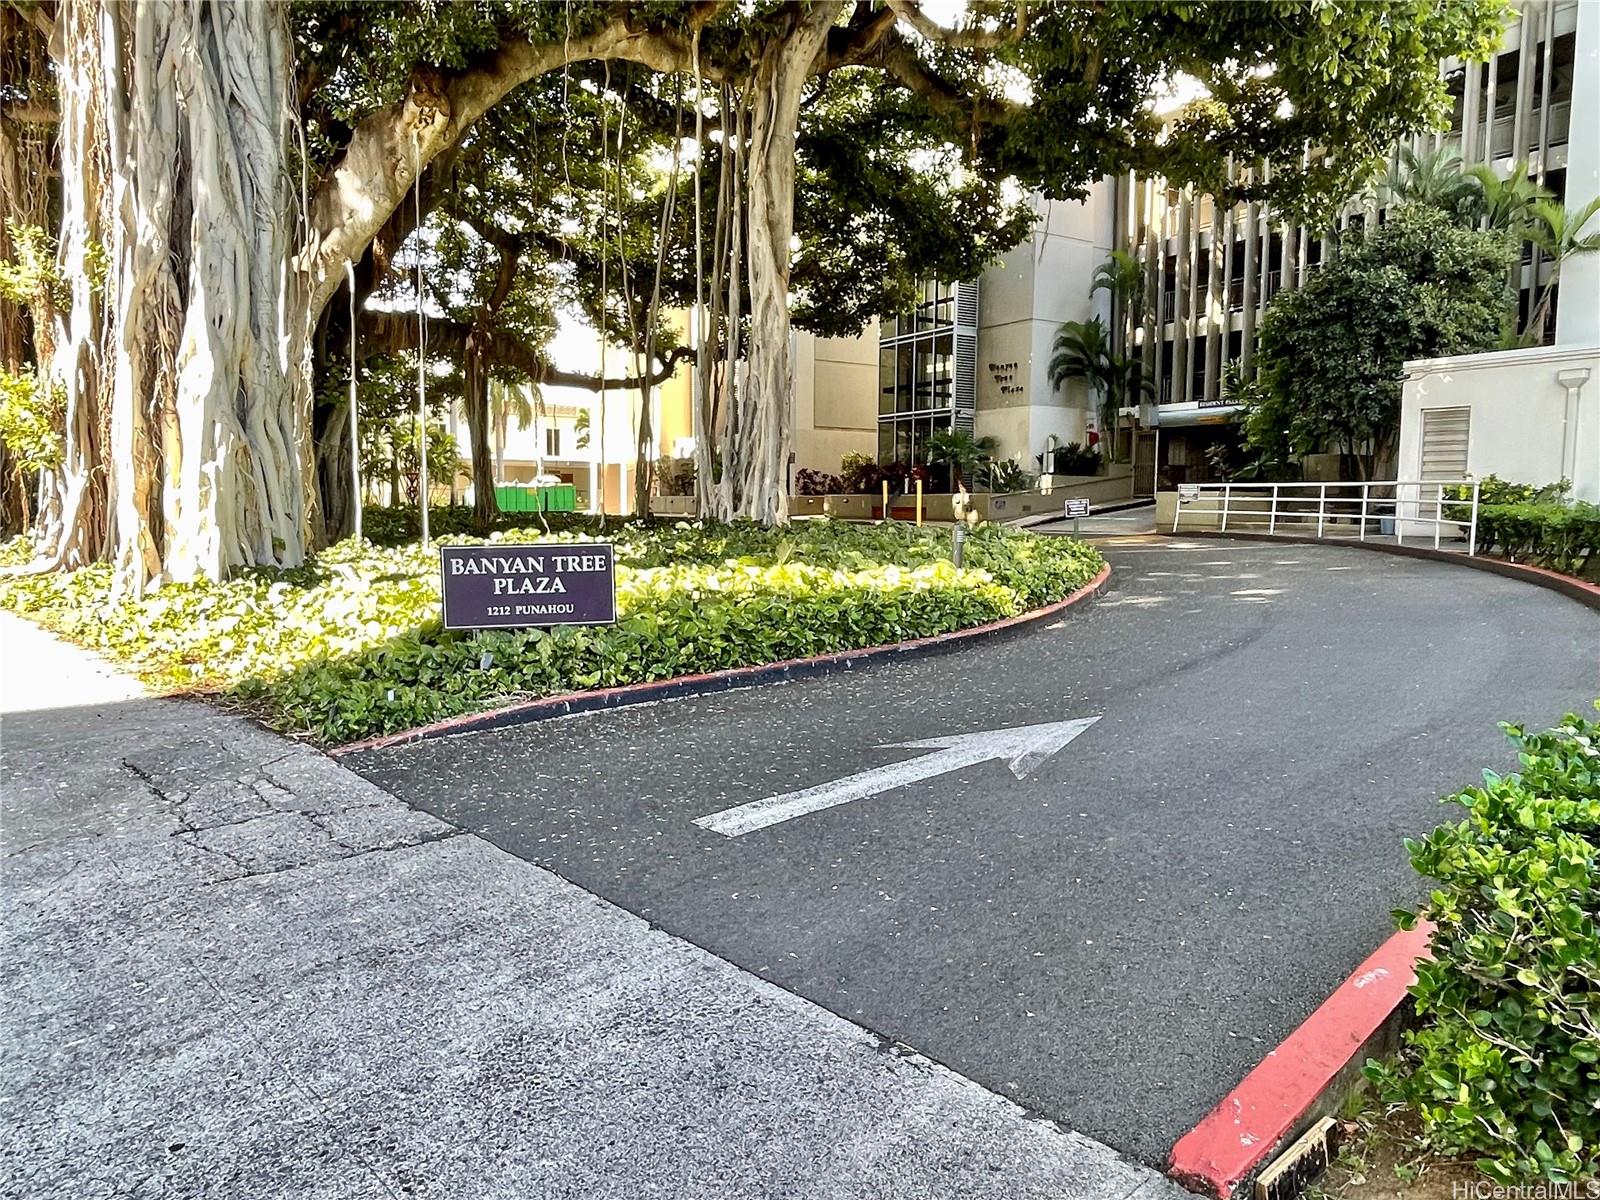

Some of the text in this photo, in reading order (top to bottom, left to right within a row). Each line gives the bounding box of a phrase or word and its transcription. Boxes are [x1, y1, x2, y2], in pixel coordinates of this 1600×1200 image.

[450, 555, 606, 575] BANYAN TREE
[493, 576, 566, 595] PLAZA
[487, 604, 574, 616] 1212 PUNAHOU
